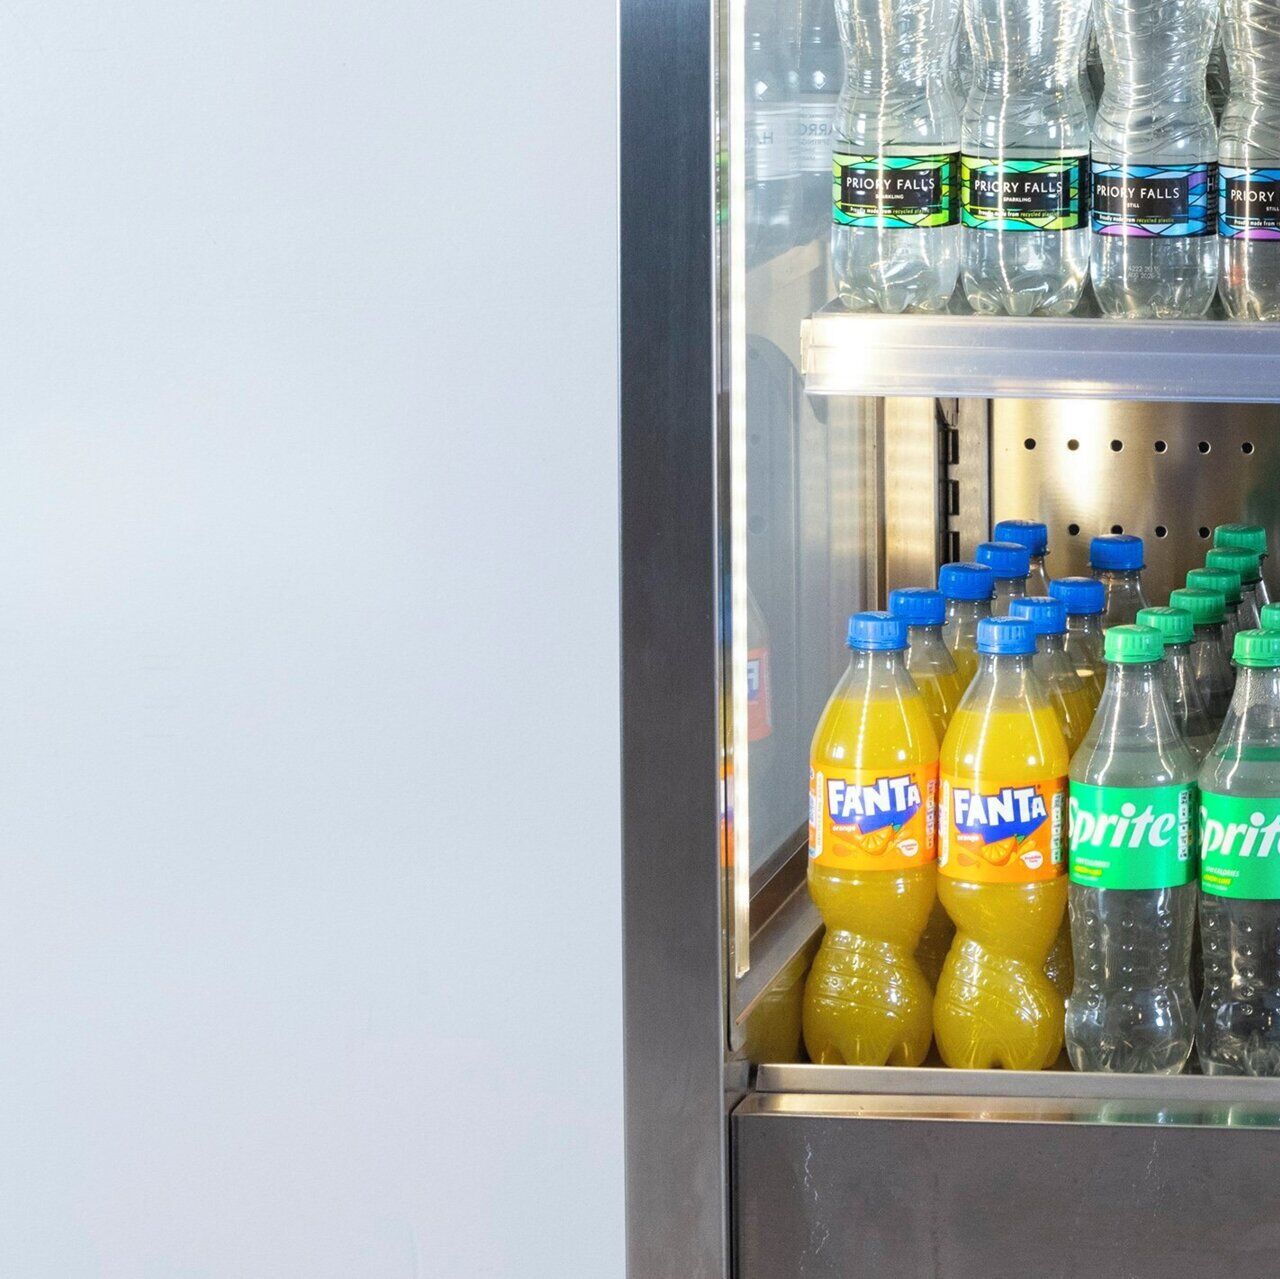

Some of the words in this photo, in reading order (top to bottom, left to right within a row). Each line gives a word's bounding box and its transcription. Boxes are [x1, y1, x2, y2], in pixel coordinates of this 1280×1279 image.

[1024, 182, 1062, 193] FALLS
[1140, 187, 1180, 199] FALLS
[827, 775, 921, 816] FANTA
[953, 787, 1046, 826] FANTA
